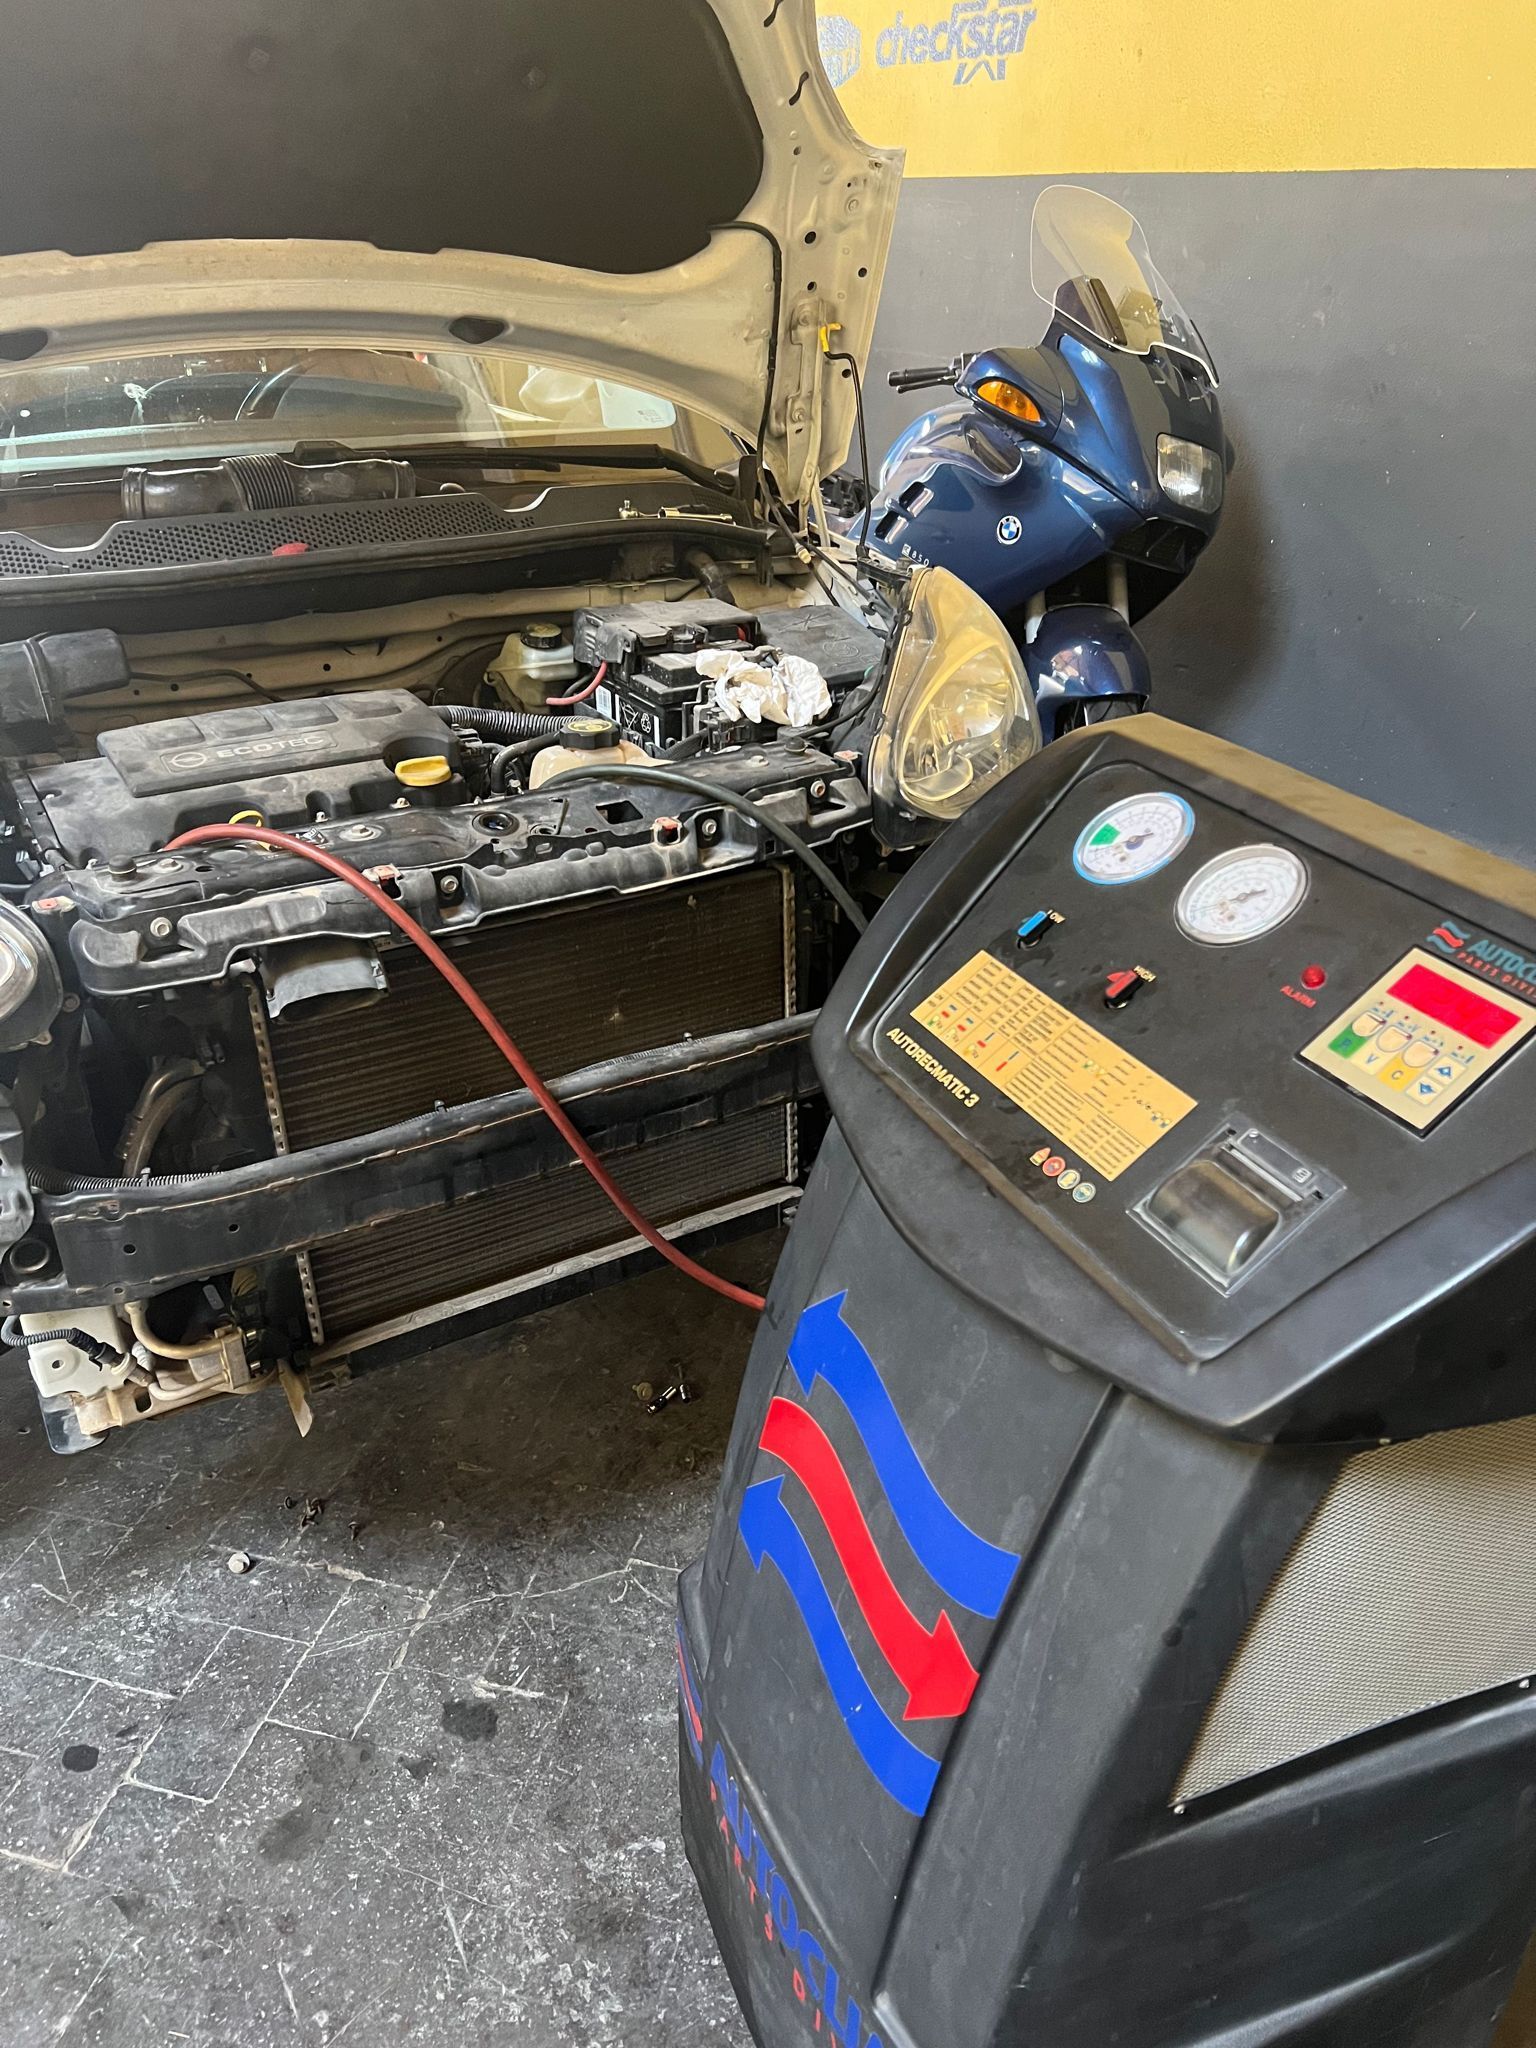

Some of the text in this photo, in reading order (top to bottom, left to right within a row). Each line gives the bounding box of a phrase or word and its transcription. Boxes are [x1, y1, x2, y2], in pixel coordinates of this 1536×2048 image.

[876, 4, 1037, 68] checkstar
[911, 550, 930, 567] 850
[216, 736, 324, 758] ECOTEC
[1133, 965, 1157, 983] HIGH
[1457, 951, 1499, 977] PARTS
[1280, 985, 1317, 1008] ALARM
[886, 1027, 980, 1108] AUTORECMATIC 3
[710, 1741, 885, 2048] AUTOCLI
